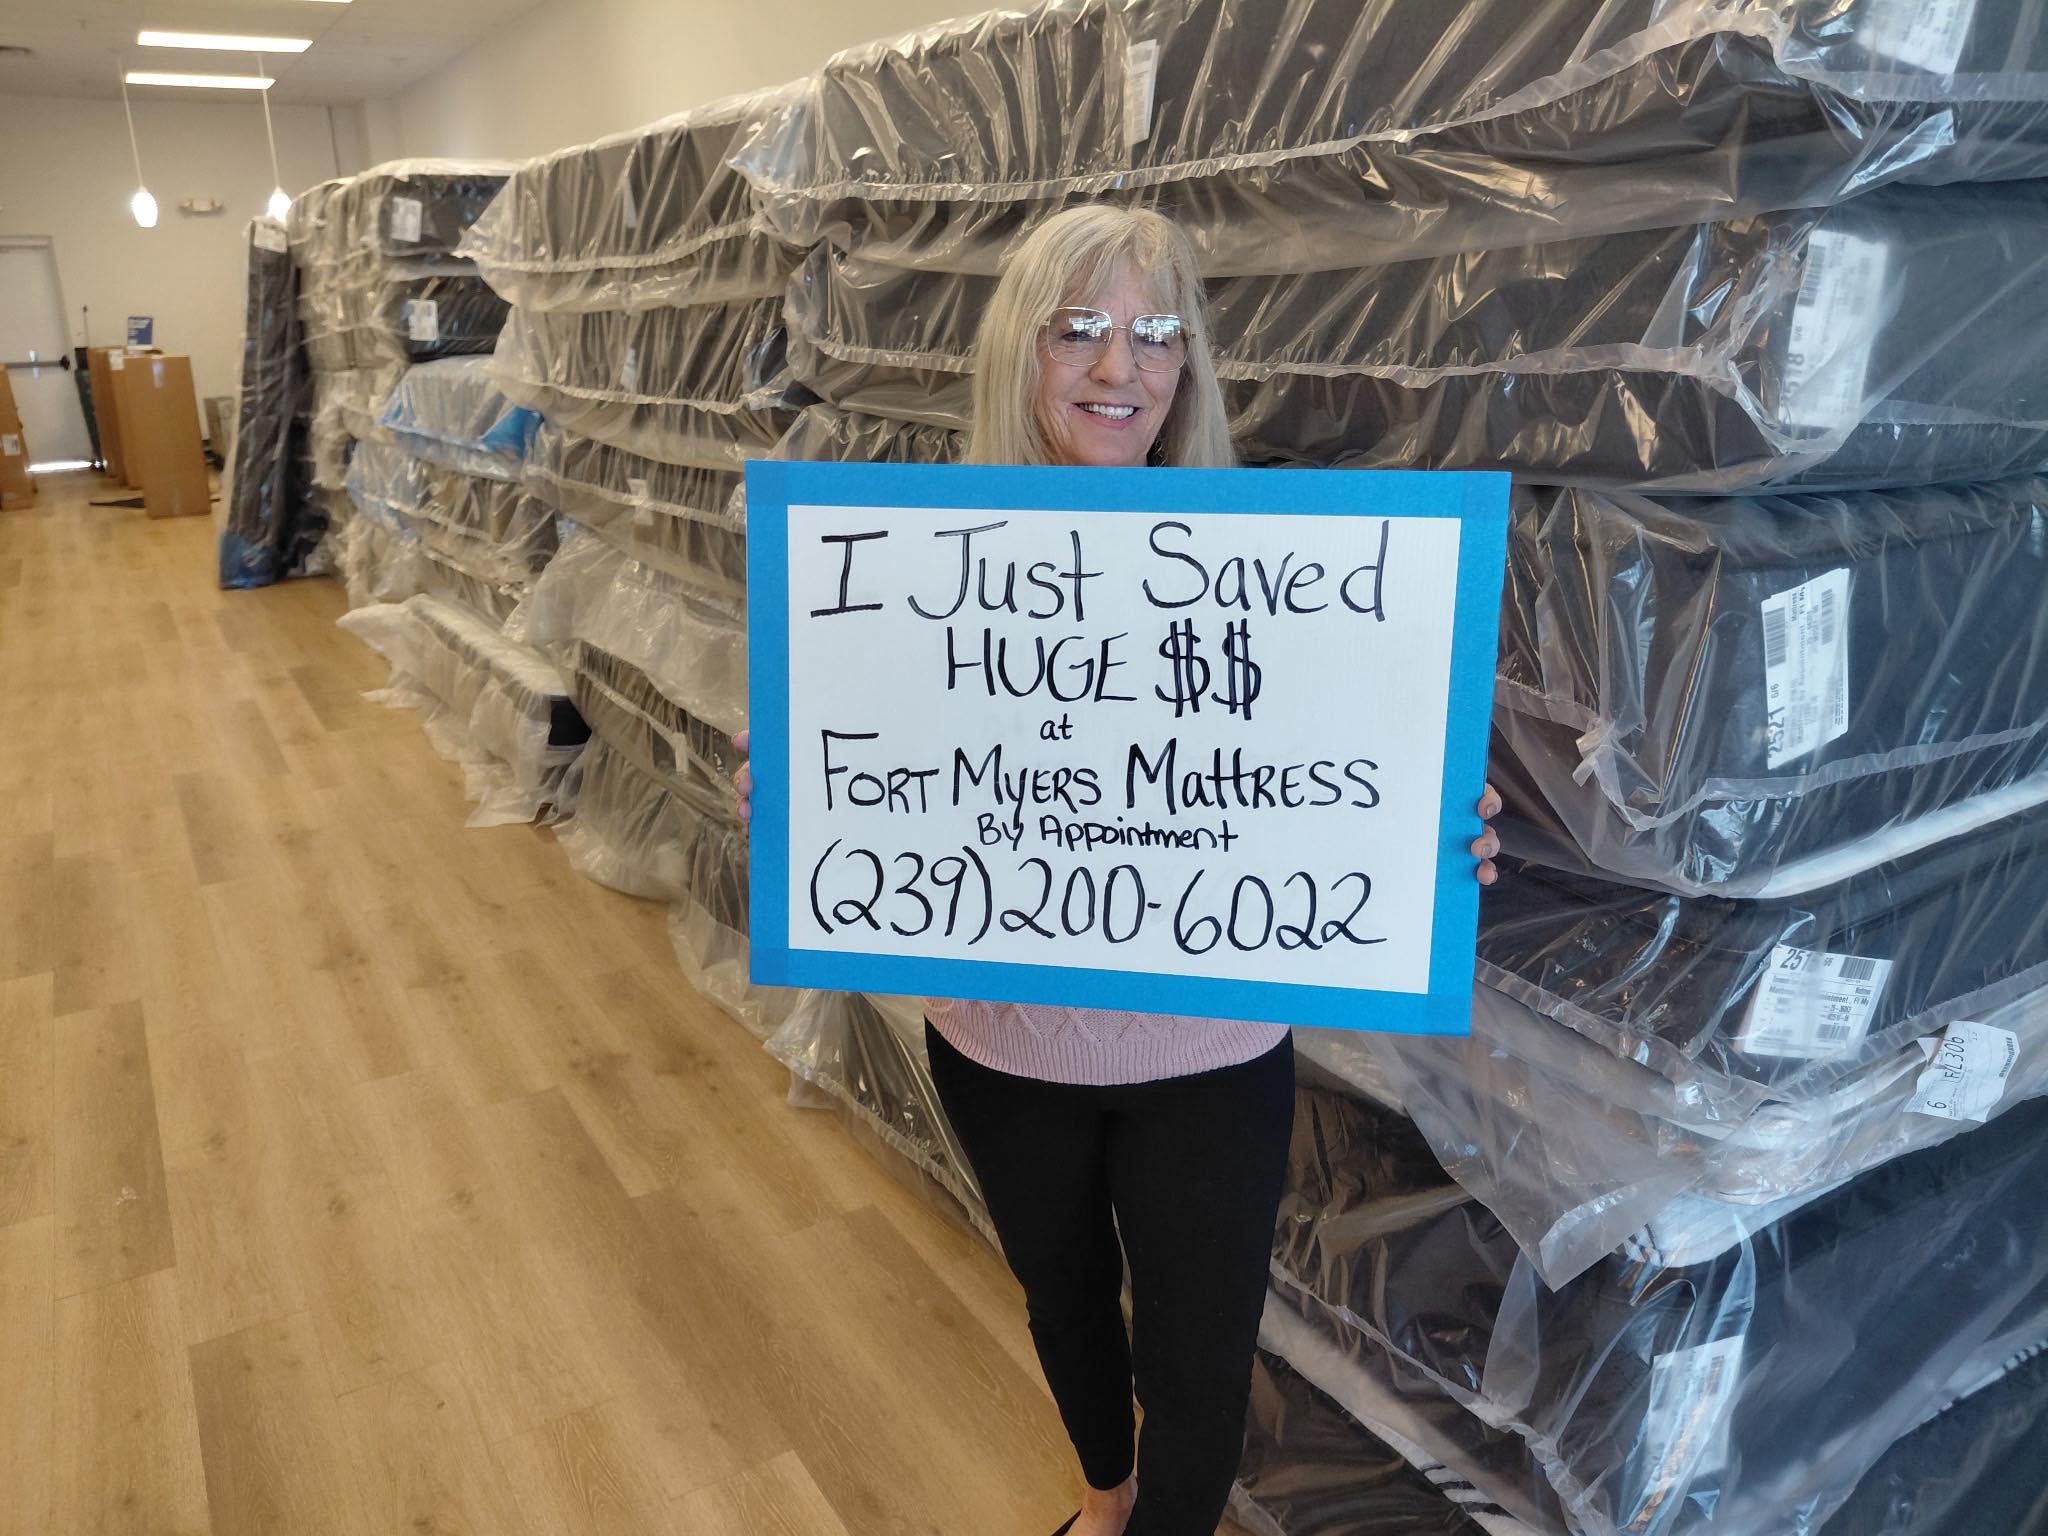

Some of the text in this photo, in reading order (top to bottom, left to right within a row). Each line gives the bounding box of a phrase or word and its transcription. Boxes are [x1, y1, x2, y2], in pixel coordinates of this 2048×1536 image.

[810, 520, 1389, 623] I Just Saved
[946, 617, 1262, 721] HUGE $$
[1039, 712, 1074, 741] at
[820, 729, 940, 814] FORT
[976, 812, 1239, 853] By Appointment
